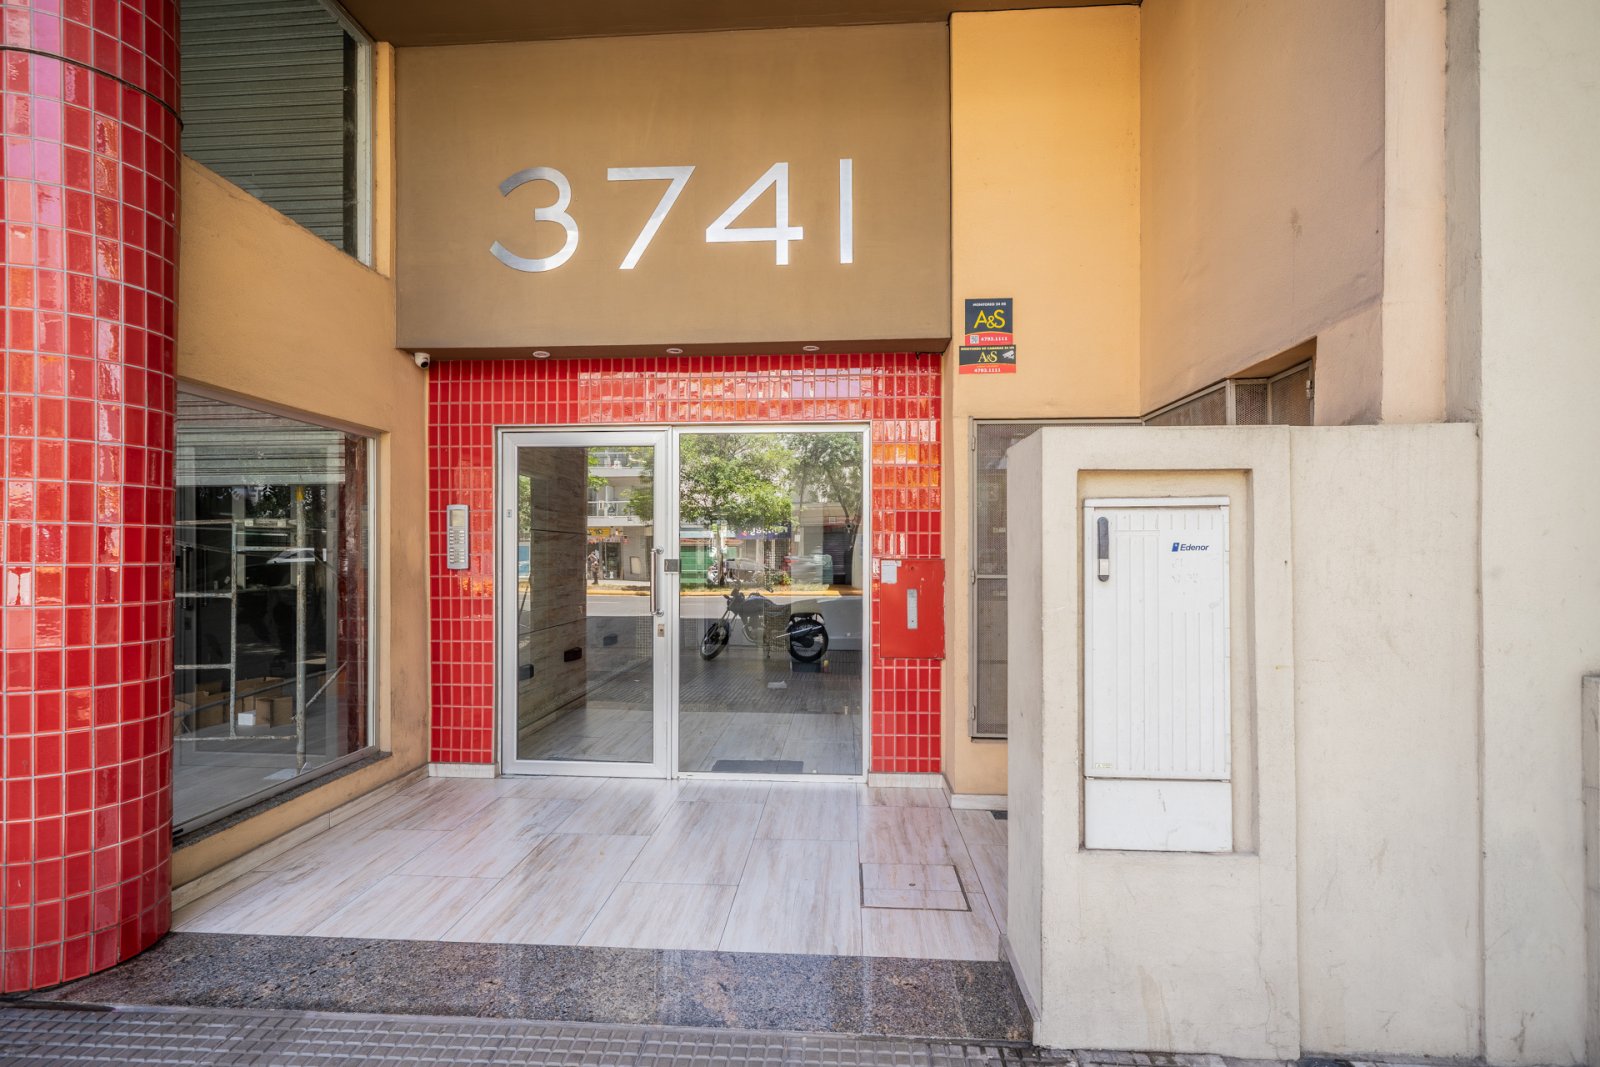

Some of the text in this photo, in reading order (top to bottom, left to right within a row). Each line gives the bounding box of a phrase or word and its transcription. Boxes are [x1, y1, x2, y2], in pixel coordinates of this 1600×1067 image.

[489, 159, 853, 273] 3741
[973, 309, 1006, 329] A&S
[977, 351, 998, 363] A&S
[1180, 543, 1209, 551] Edenor
